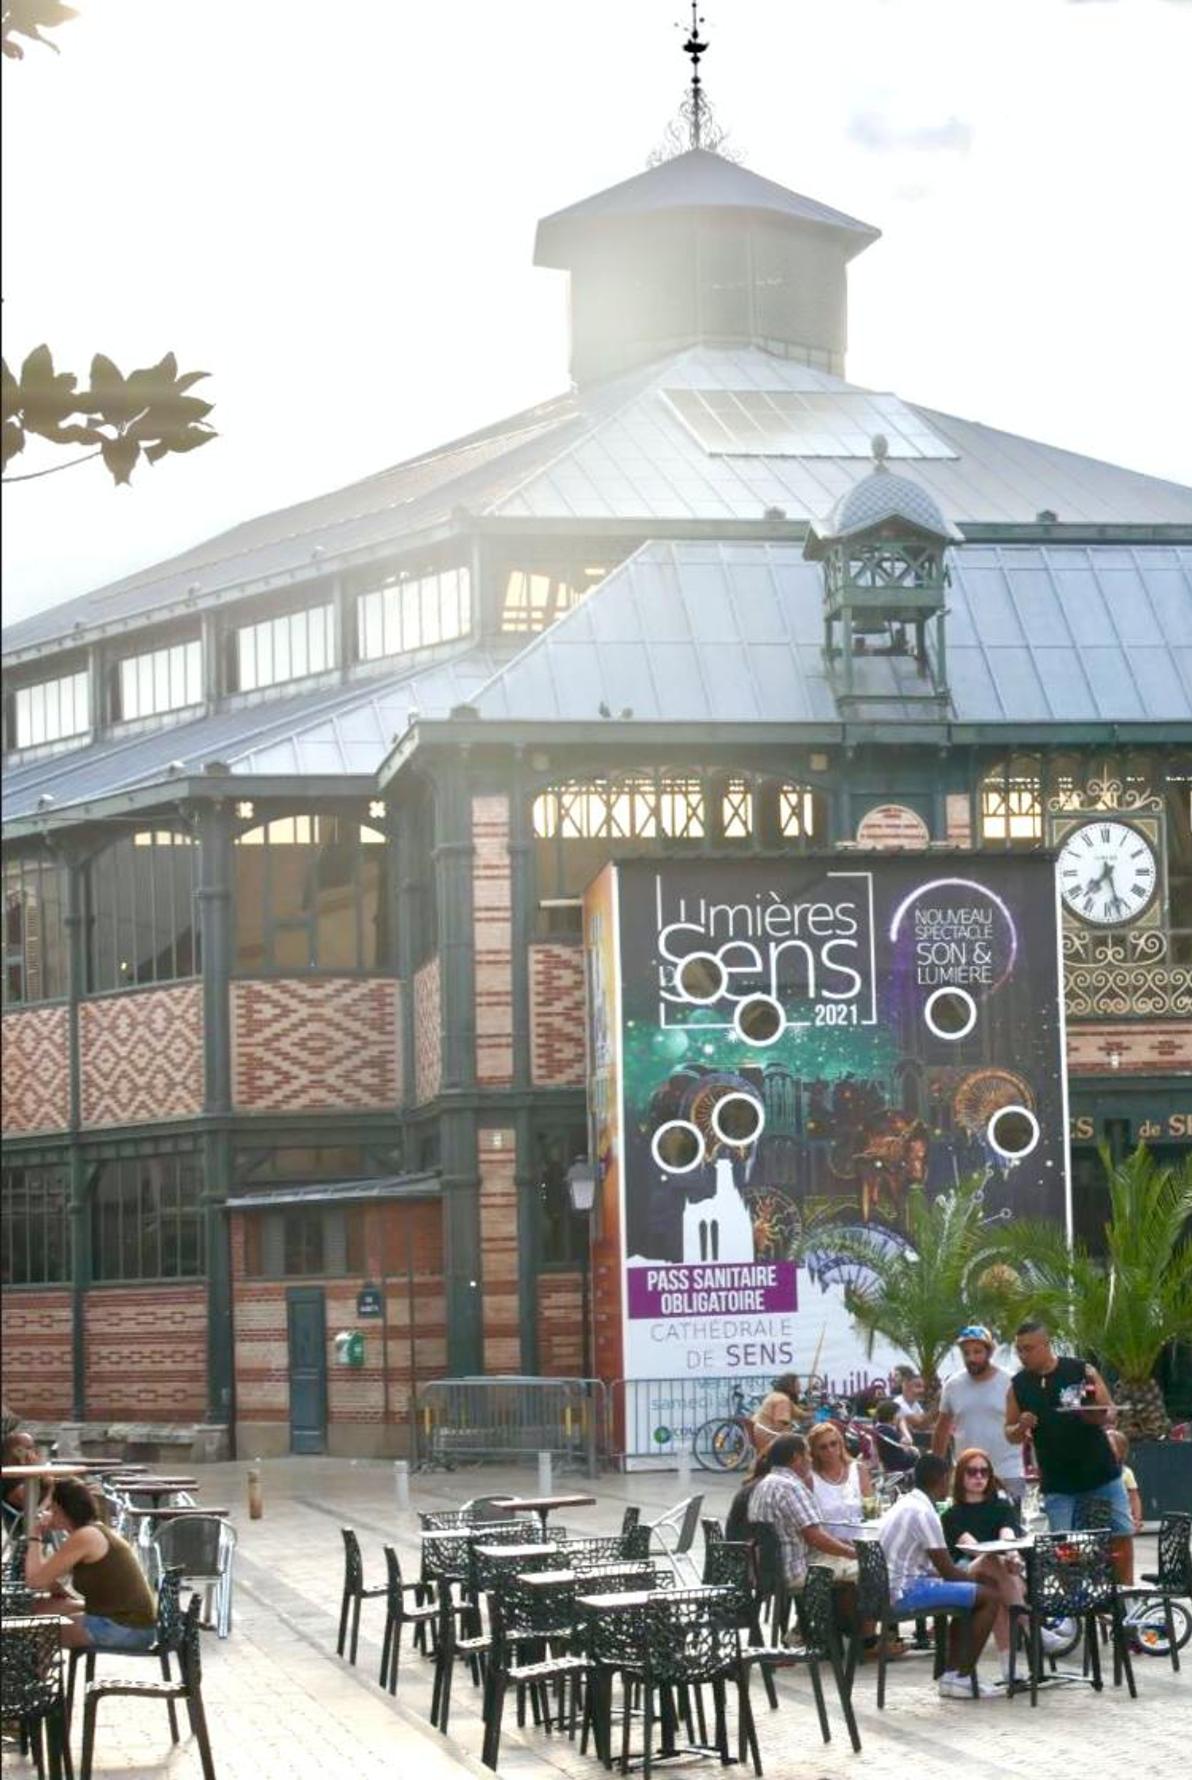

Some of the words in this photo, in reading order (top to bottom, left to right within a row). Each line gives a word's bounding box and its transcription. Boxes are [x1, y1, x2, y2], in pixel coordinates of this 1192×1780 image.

[914, 908, 993, 925] NOUVEAU
[914, 924, 993, 940] SPECTACLE
[916, 941, 966, 966] SON
[972, 941, 992, 964] &
[814, 1004, 858, 1026] 2021
[1138, 1119, 1162, 1138] de
[647, 1268, 690, 1292] PASS
[692, 1265, 778, 1290] SANITAIRE
[660, 1289, 766, 1315] OBLIGATOIRE
[686, 1349, 713, 1370] DE
[726, 1341, 794, 1368] SENS
